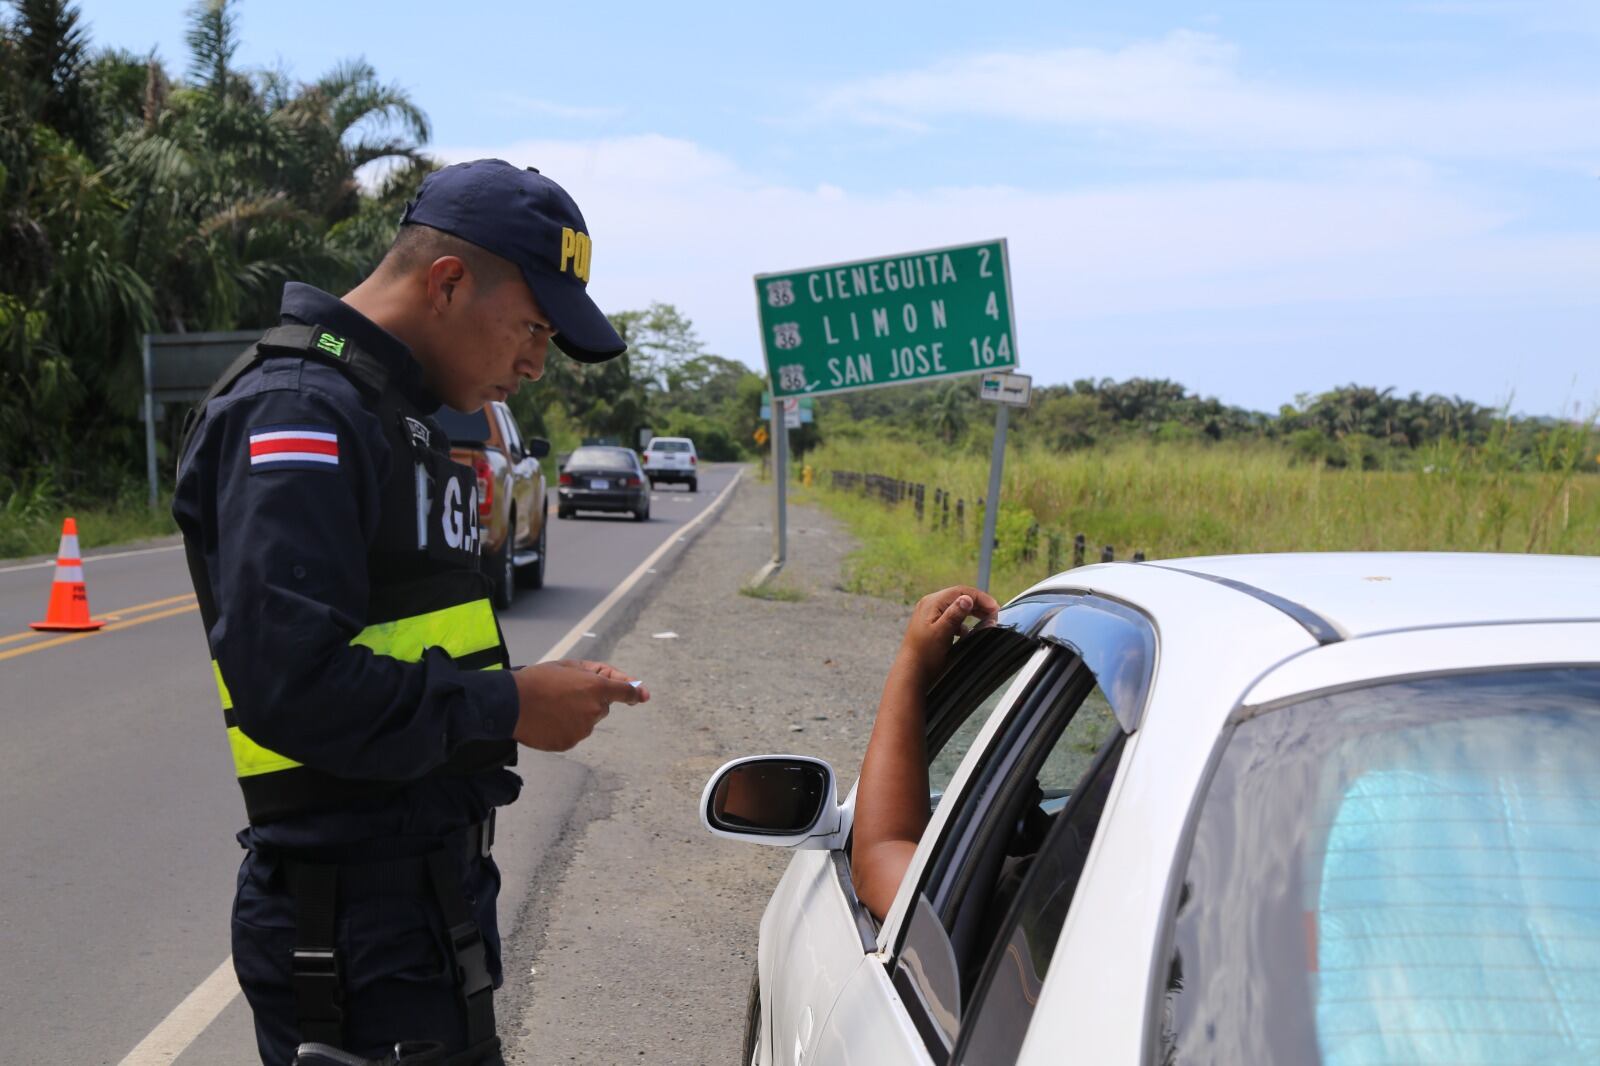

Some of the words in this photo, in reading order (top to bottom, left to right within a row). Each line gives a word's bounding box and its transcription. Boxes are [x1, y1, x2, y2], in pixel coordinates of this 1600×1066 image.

[808, 253, 957, 303] CIENEGUITA
[977, 248, 993, 278] 2
[823, 299, 948, 345] LIMON
[985, 291, 999, 320] 4
[827, 353, 874, 386] SAN
[889, 342, 947, 378] JOSE
[969, 333, 1011, 366] 164
